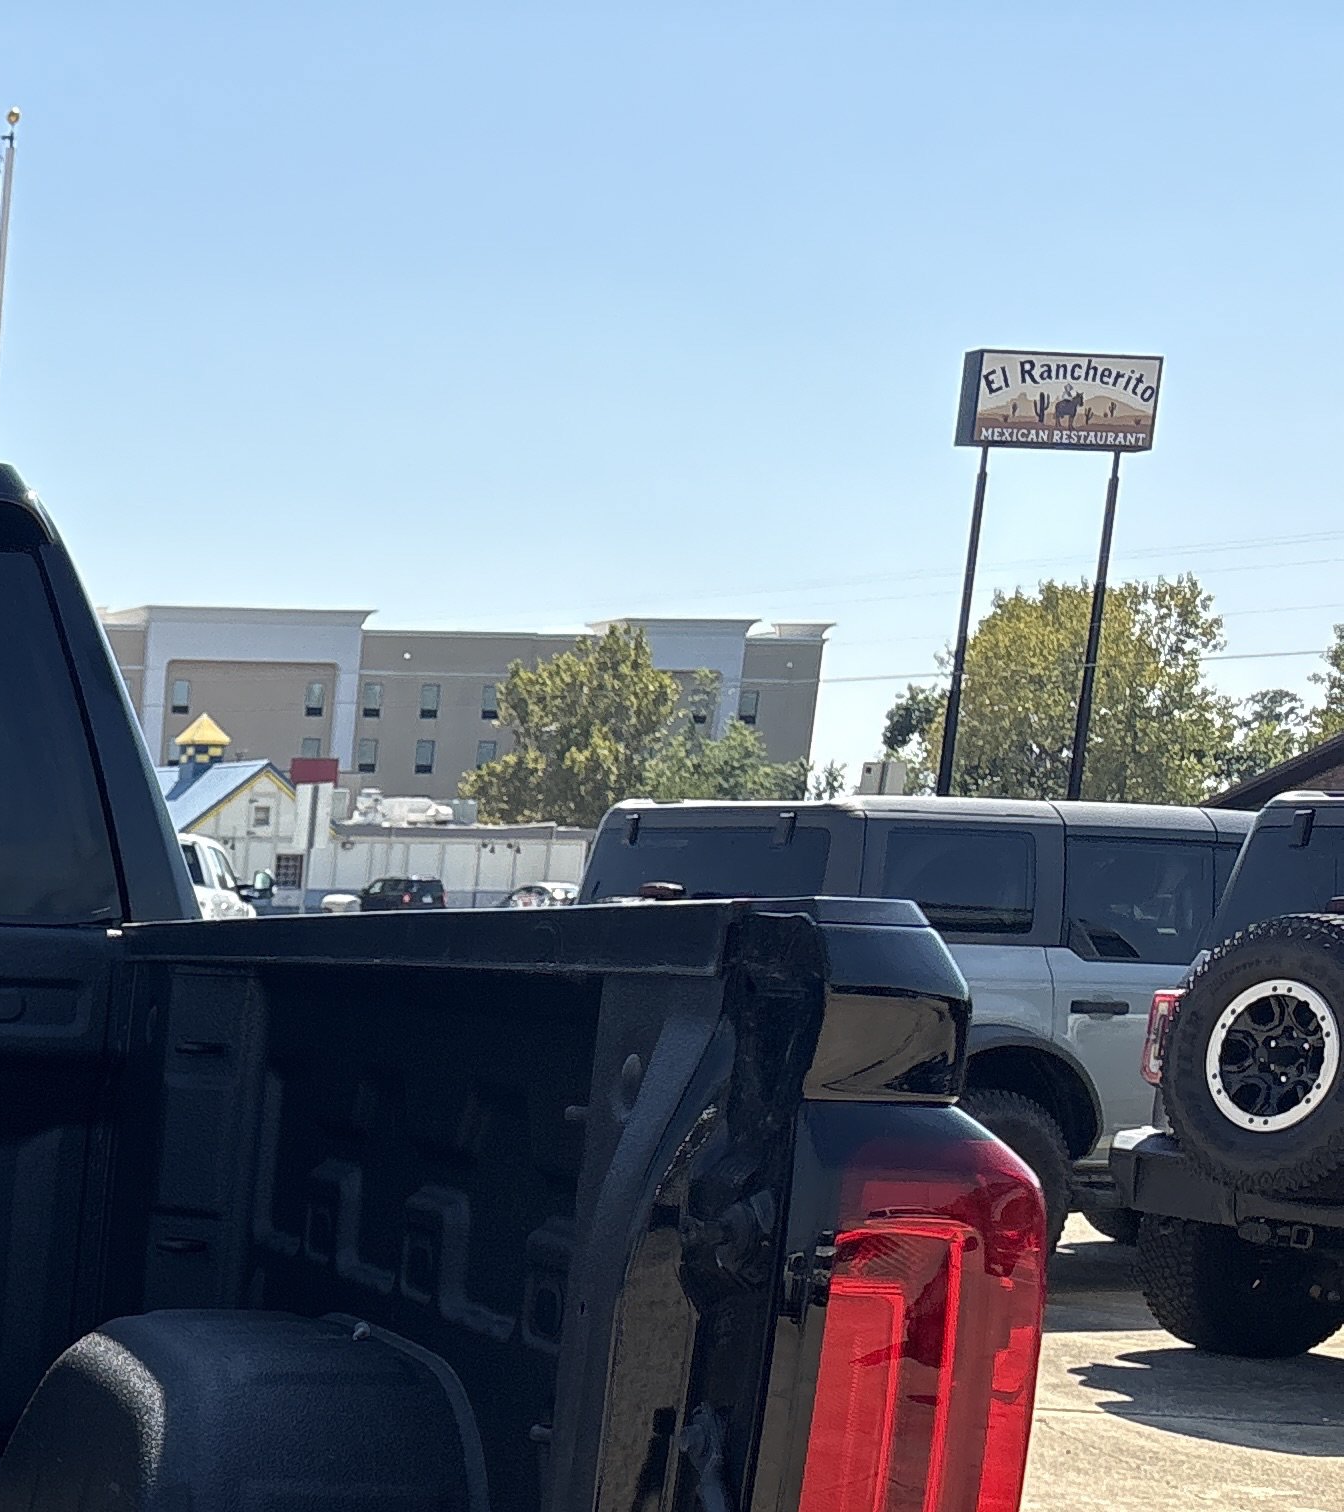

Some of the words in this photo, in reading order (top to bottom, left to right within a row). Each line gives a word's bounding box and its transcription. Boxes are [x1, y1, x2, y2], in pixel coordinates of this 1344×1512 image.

[982, 365, 1011, 395] El
[1018, 358, 1156, 403] Rancherito
[979, 427, 1050, 443] MEXICAN
[1052, 430, 1147, 447] RESTAURANT
